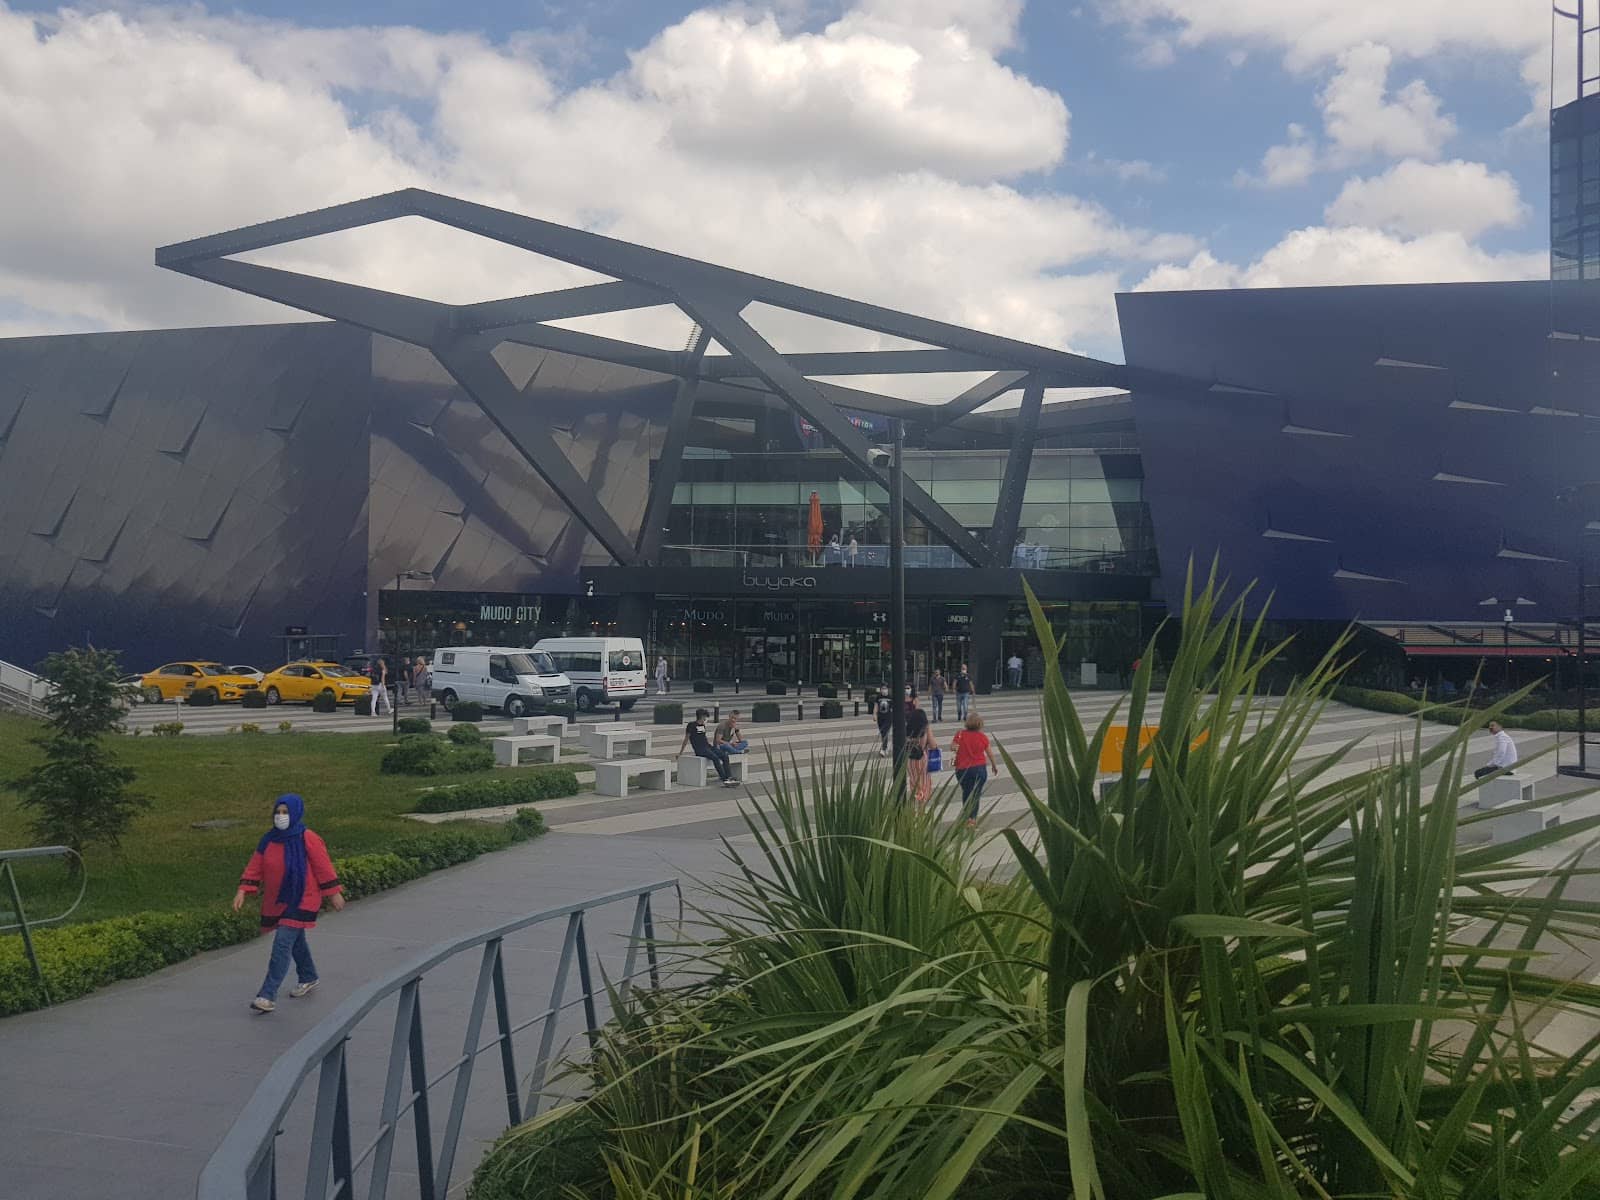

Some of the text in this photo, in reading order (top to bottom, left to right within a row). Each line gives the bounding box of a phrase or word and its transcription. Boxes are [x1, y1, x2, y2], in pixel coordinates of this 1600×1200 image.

[743, 573, 817, 590] buyaka
[480, 606, 542, 621] MUDO CITY
